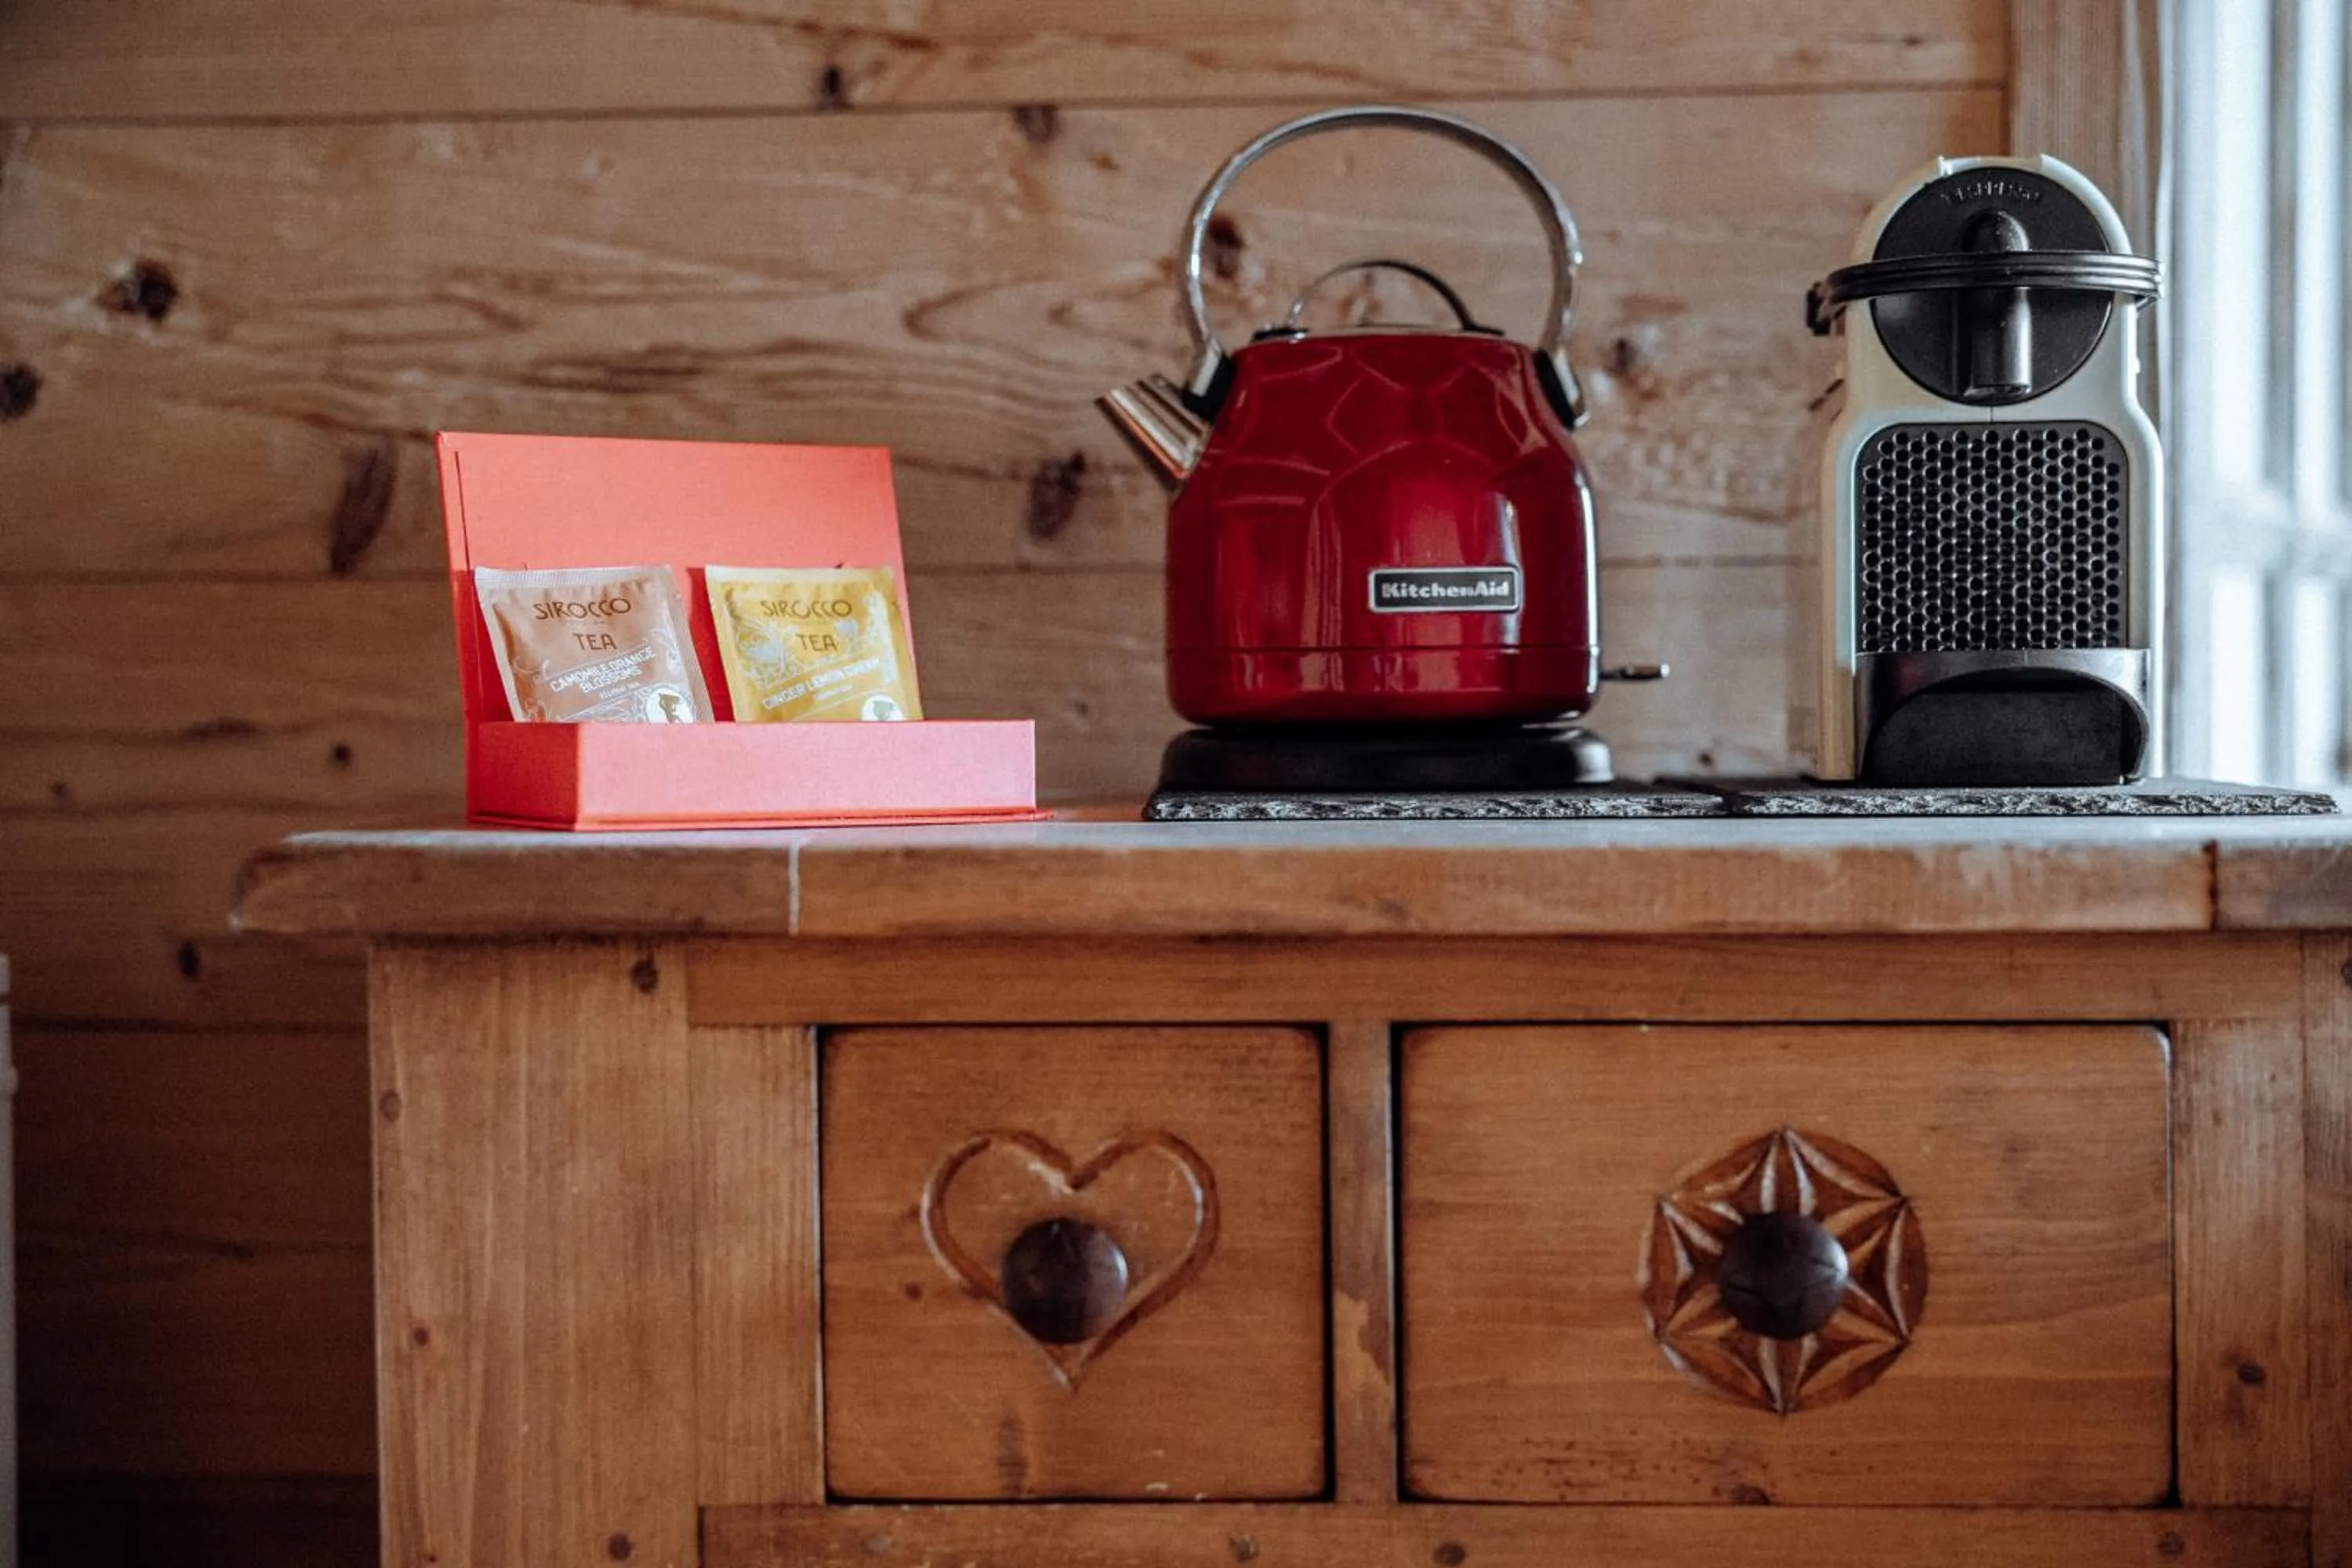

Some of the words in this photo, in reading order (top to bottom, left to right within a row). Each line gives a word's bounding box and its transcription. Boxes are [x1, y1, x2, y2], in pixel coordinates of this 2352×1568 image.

[1381, 580, 1510, 599] KitchenAid
[533, 598, 631, 620] SIROCCO
[759, 599, 853, 618] SIROCCO
[573, 633, 617, 651] TEA
[795, 633, 837, 652] TEA
[550, 664, 608, 692] CAMOMILE
